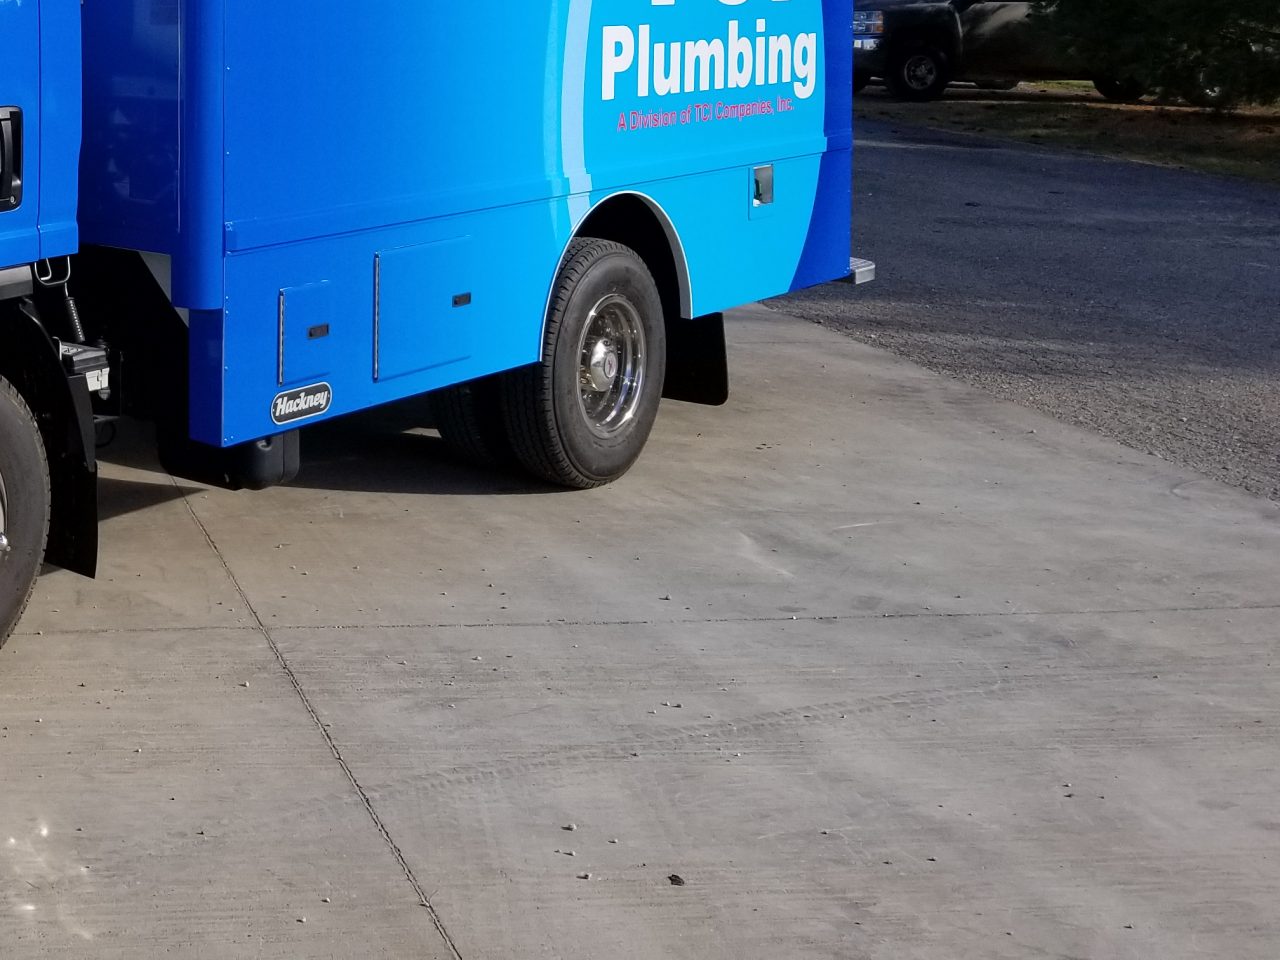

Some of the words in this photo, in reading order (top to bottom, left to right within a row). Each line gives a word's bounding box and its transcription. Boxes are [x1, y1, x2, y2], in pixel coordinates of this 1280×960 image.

[601, 18, 817, 101] Plumbing
[617, 112, 627, 131] A
[630, 109, 677, 130] Division
[680, 105, 692, 124] of
[694, 103, 713, 122] TCI
[715, 99, 775, 121] Companies,
[776, 96, 795, 112] Inc.
[276, 391, 328, 416] Hackney
